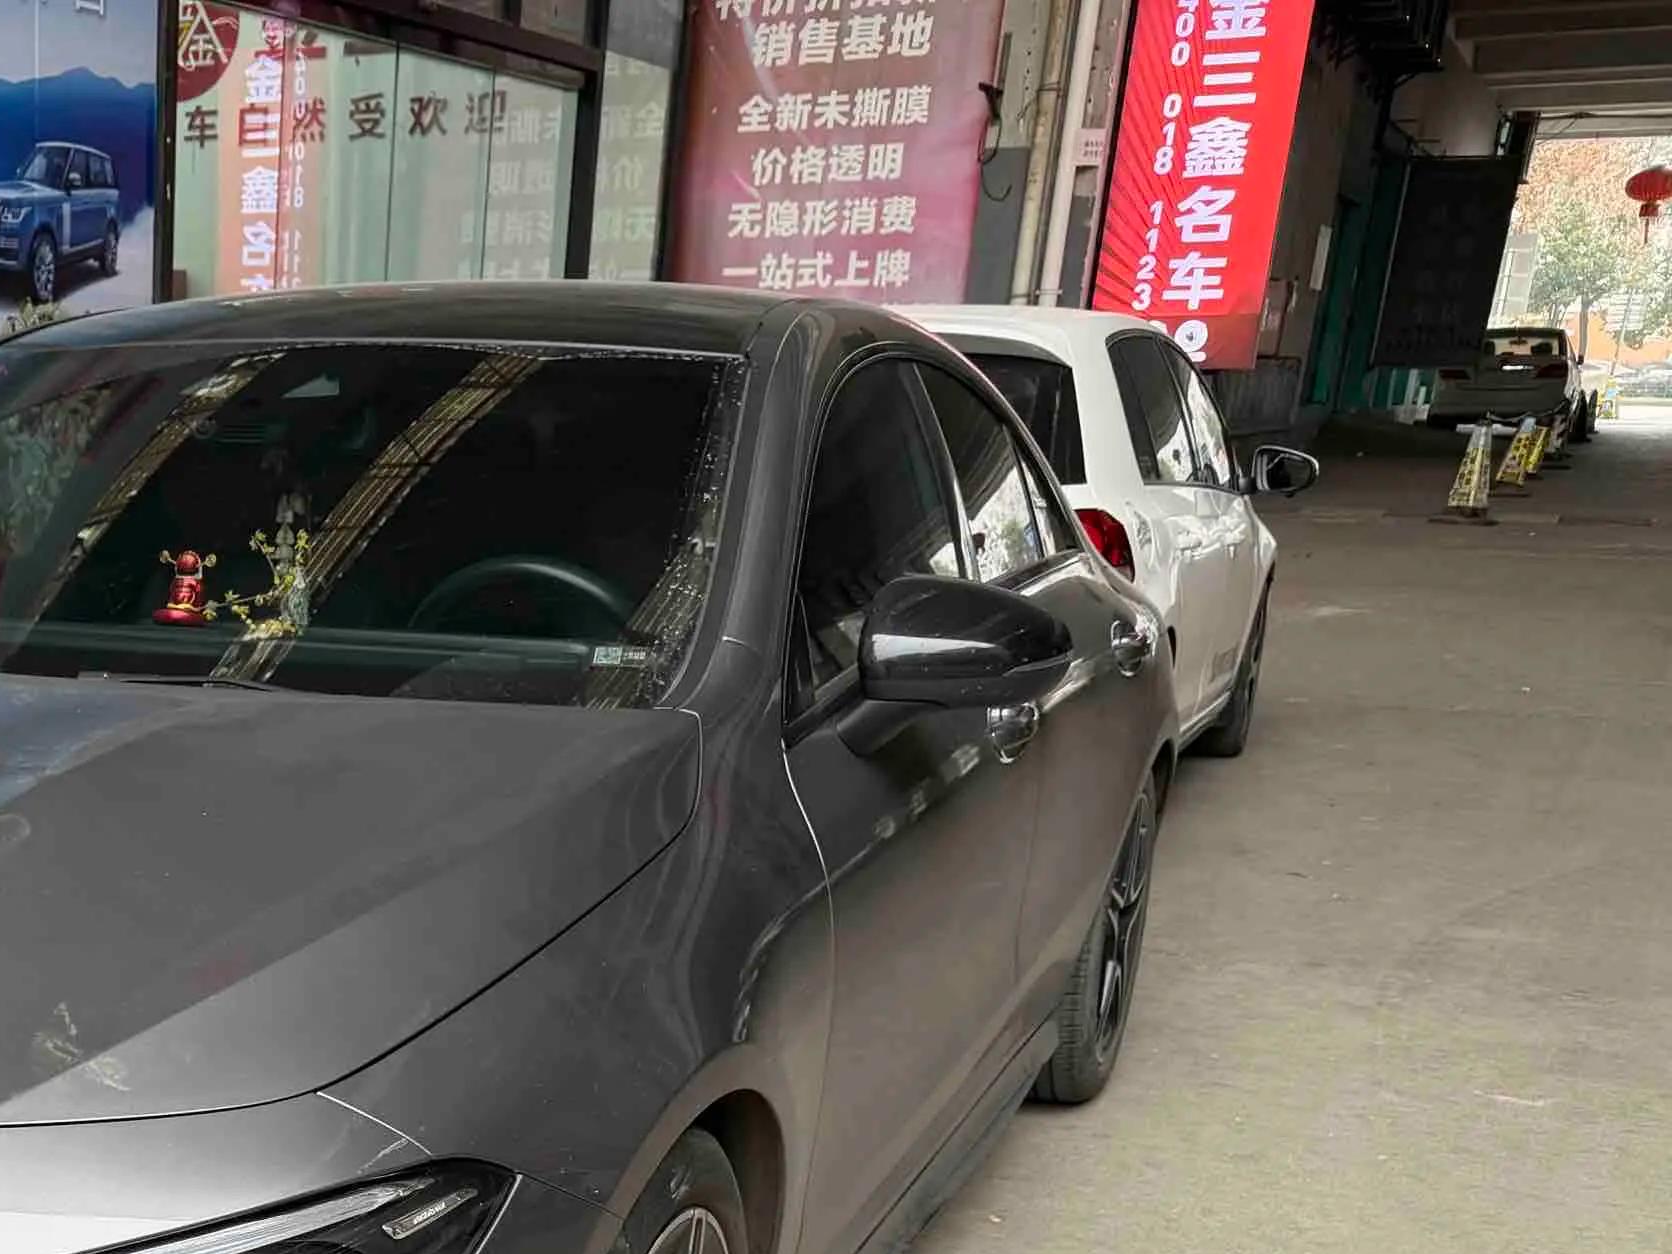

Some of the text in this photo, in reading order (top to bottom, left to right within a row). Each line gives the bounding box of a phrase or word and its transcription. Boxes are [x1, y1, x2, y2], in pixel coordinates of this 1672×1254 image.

[752, 10, 935, 68] 销售基地
[737, 84, 932, 134] 全新未撕膜
[1152, 92, 1183, 177] 018
[751, 142, 906, 187] 价格透明
[1161, 0, 1273, 311] 金三鑫名车
[728, 195, 917, 239] 无隐形消费
[722, 248, 911, 290] 一站式上牌
[1130, 199, 1165, 311] 1123
